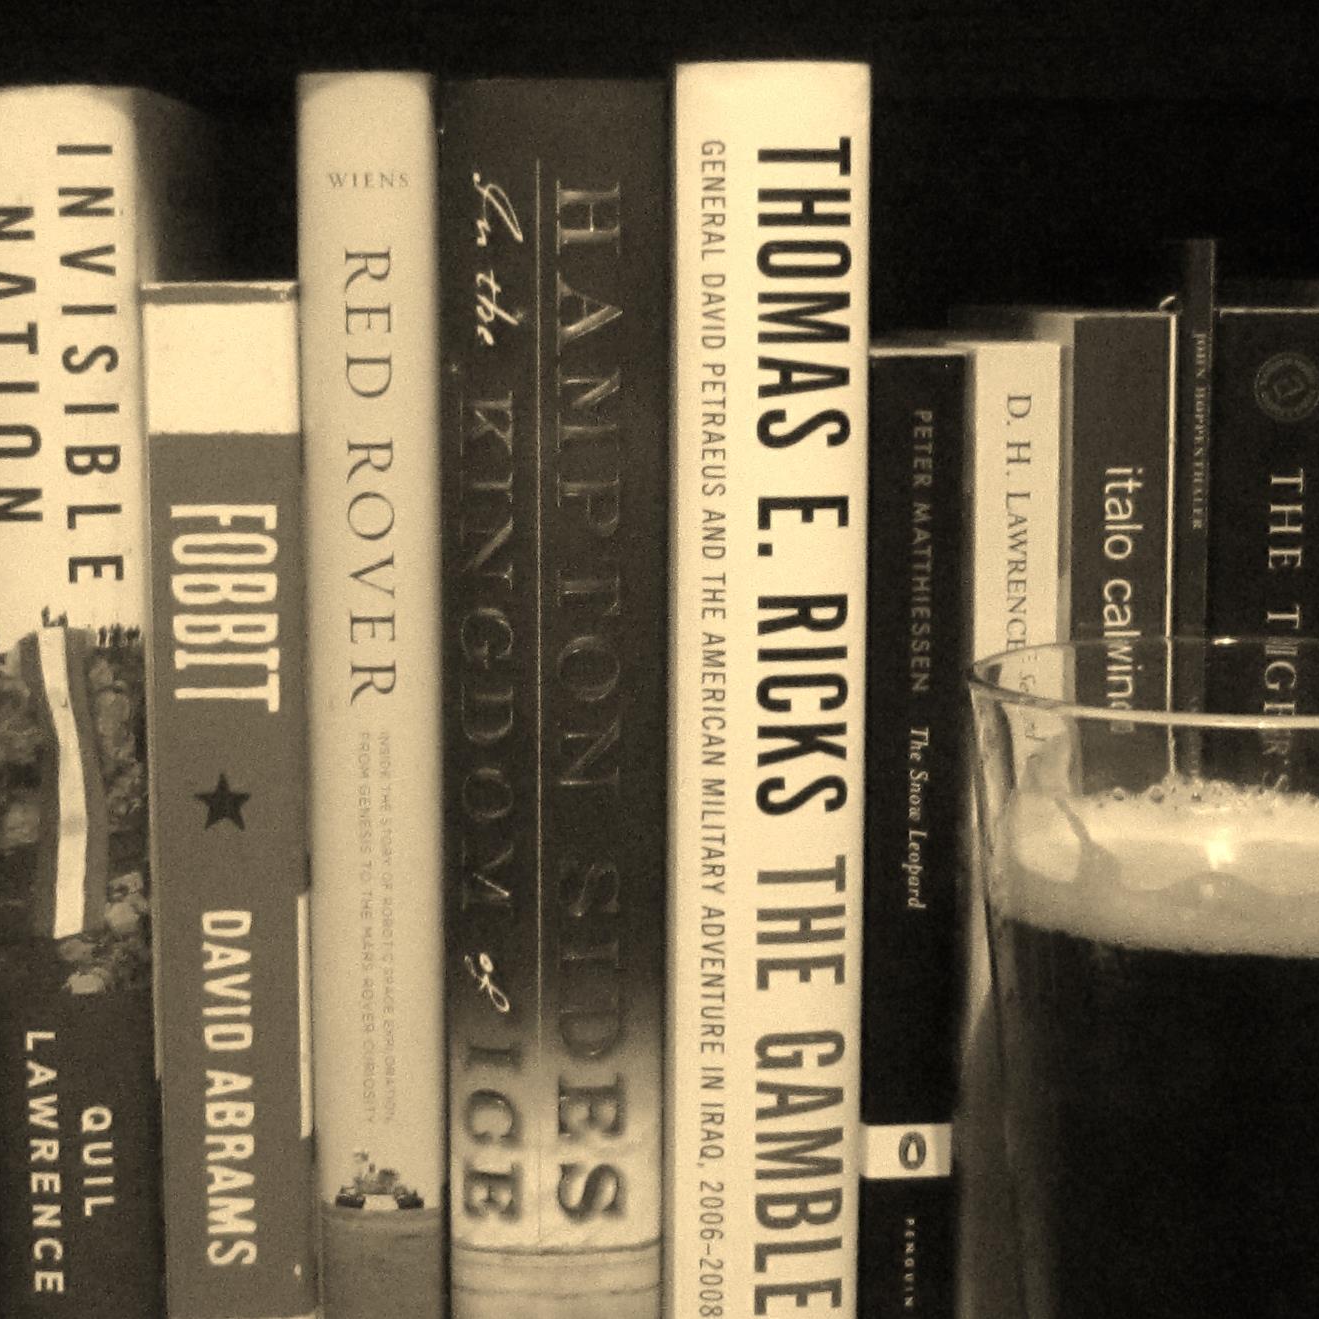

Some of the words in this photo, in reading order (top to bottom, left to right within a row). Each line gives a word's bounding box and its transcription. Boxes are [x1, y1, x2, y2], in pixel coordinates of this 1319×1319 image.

[327, 171, 411, 190] WIENS
[471, 172, 524, 248] In
[700, 139, 727, 262] GENERAL
[344, 245, 394, 400] RED
[475, 268, 522, 346] the
[700, 272, 727, 351] DAVID
[756, 135, 852, 449] THOMAS
[56, 144, 124, 584] INVISIBLE
[1005, 390, 1033, 427] D.
[700, 363, 727, 498] PETRAEUS
[911, 409, 933, 488] PETER
[1004, 439, 1032, 478] H.
[701, 508, 727, 561] AND
[756, 495, 850, 558] E.
[1103, 466, 1145, 560] italo
[1268, 468, 1304, 570] THE
[170, 503, 282, 713] FOBBIT
[345, 438, 398, 706] ROVER
[701, 573, 727, 622] THE
[909, 500, 933, 692] MATTHIESSEN
[700, 632, 728, 767] AMERICAN
[756, 593, 850, 817] RICKS
[908, 725, 931, 761] The
[700, 778, 728, 895] MILITARY
[909, 765, 930, 820] Snow
[756, 854, 847, 992] THE
[905, 829, 929, 910] Leopard
[201, 909, 254, 1053] DAVID
[699, 906, 727, 1056] ADVENTURE
[556, 862, 626, 1226] SIDES
[699, 1063, 726, 1089] IN
[25, 1030, 64, 1294] LAWRENCE
[80, 1106, 114, 1219] QUIL
[204, 1069, 258, 1268] ABRAMS
[463, 1043, 524, 1222] ICE
[696, 1101, 726, 1169] IRAQ,
[754, 1028, 847, 1318] GAMBLE
[903, 1218, 916, 1308] PENGUIN
